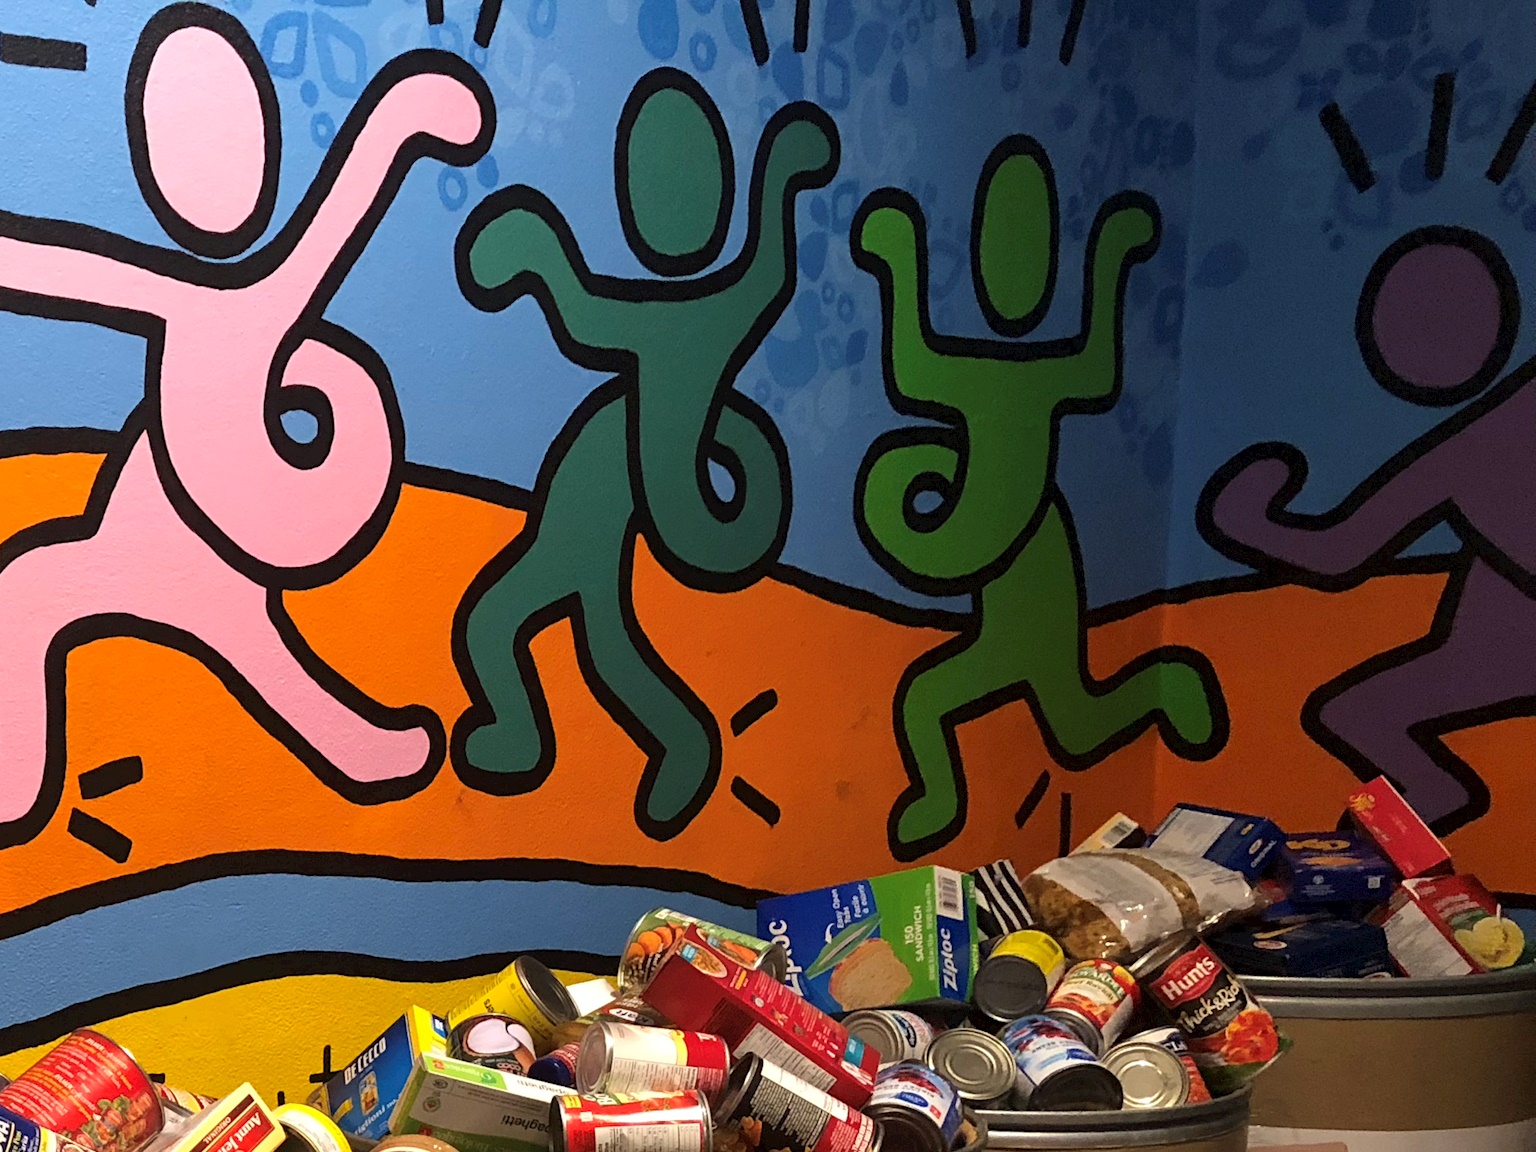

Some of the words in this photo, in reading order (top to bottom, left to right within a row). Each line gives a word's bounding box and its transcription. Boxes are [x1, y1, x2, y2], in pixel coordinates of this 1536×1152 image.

[905, 925, 913, 945] 150
[914, 905, 924, 962] SANDWICH
[941, 928, 959, 992] Ziploc
[357, 1036, 387, 1073] CECCO
[203, 1115, 232, 1144] ORIGINAL
[237, 1112, 262, 1142] Aunt
